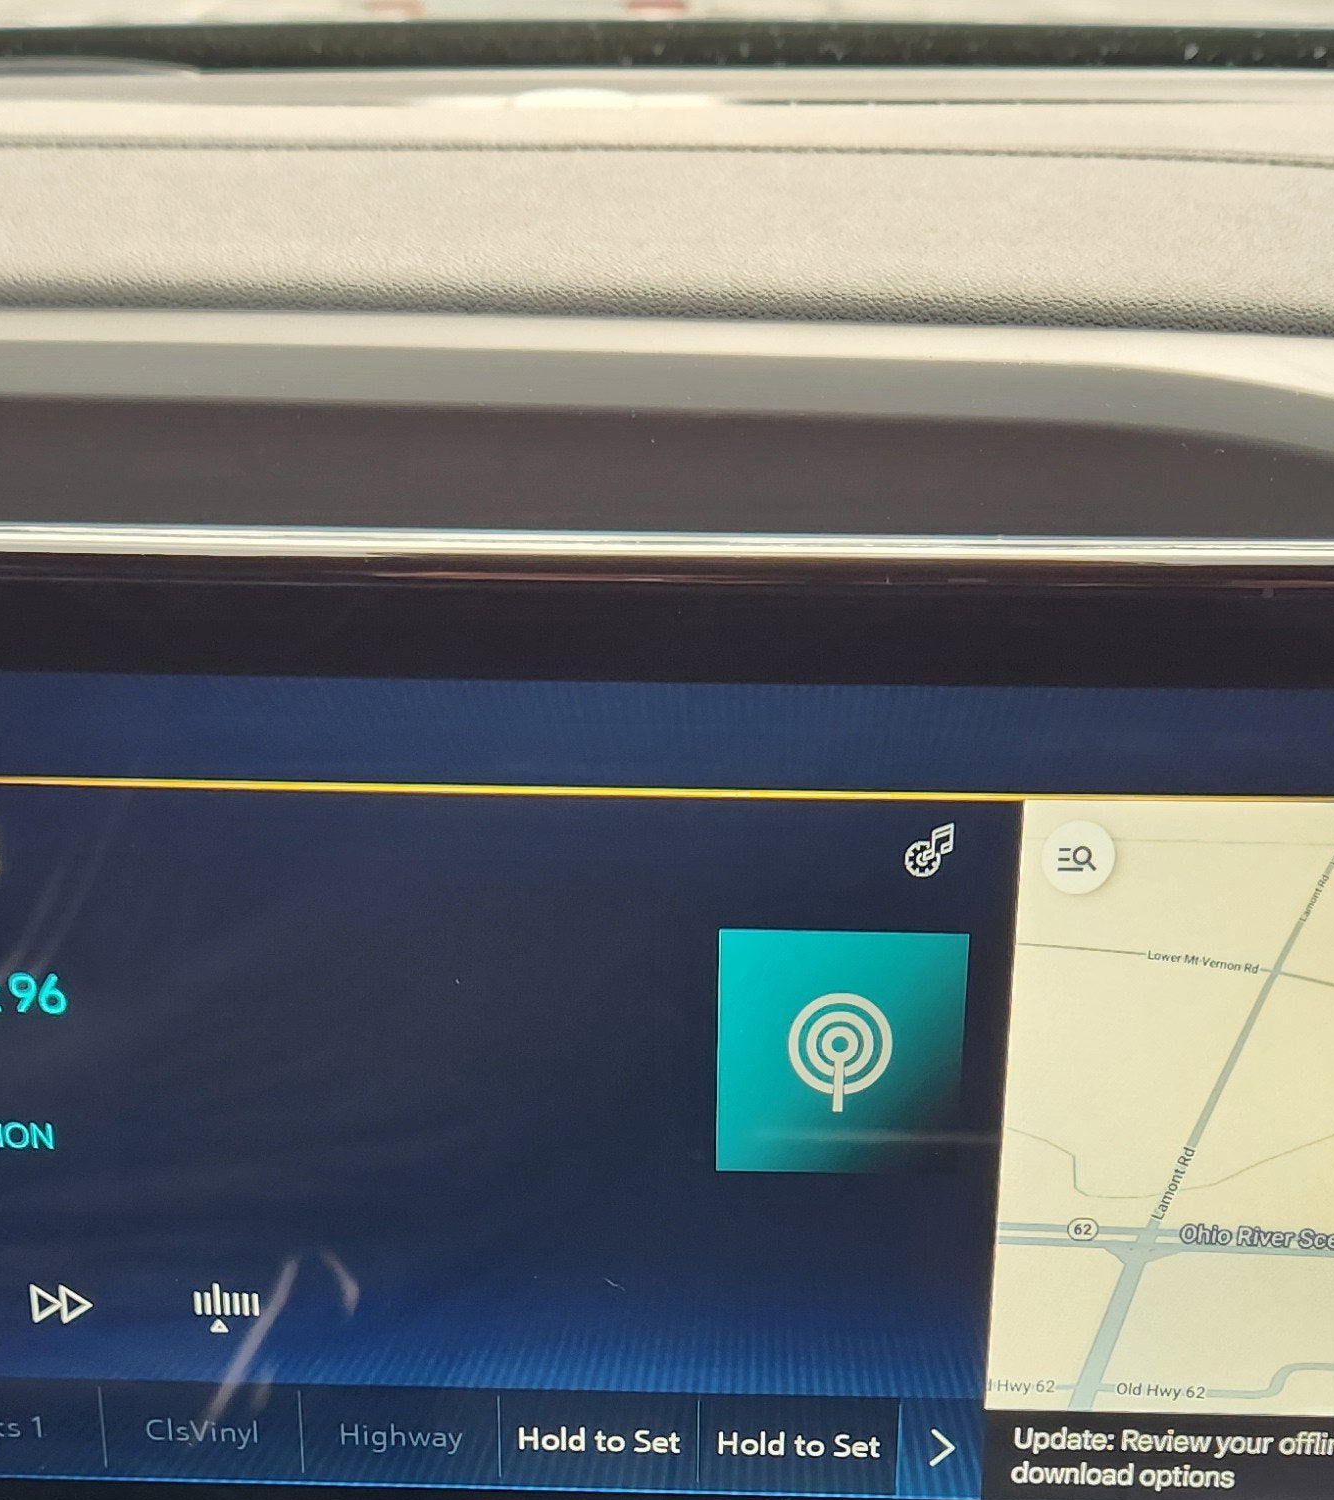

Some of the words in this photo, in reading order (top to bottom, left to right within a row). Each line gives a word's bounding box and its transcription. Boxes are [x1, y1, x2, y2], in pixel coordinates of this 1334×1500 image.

[1300, 887, 1322, 922] Lamont
[1317, 874, 1329, 889] Rd
[1147, 949, 1181, 964] Lower
[1185, 954, 1199, 966] Mt
[1202, 957, 1241, 971] Vernon
[1244, 963, 1259, 974] Rd
[8, 972, 67, 1016] 96
[1151, 1167, 1184, 1221] Lamont
[1177, 1146, 1196, 1169] Rd
[1073, 1222, 1093, 1237] 62
[1179, 1223, 1232, 1246] Ohio
[1236, 1226, 1293, 1248] River
[997, 1380, 1033, 1395] Hwy
[1036, 1380, 1055, 1393] 62
[1116, 1382, 1143, 1397] Old
[1147, 1384, 1181, 1400] Hwy
[1185, 1385, 1206, 1399] 62
[32, 1416, 44, 1439] 1
[145, 1417, 260, 1449] ClsVinyl
[340, 1423, 463, 1456] Highway
[517, 1426, 585, 1454] Hold
[595, 1430, 625, 1455] to
[633, 1429, 681, 1456] Set
[717, 1430, 785, 1458] Hold
[794, 1433, 825, 1459] to
[832, 1433, 881, 1460] Set
[1013, 1427, 1115, 1455] Update:
[1121, 1430, 1212, 1454] Review
[1215, 1436, 1273, 1459] your
[1011, 1462, 1134, 1487] download
[1138, 1463, 1235, 1491] options
